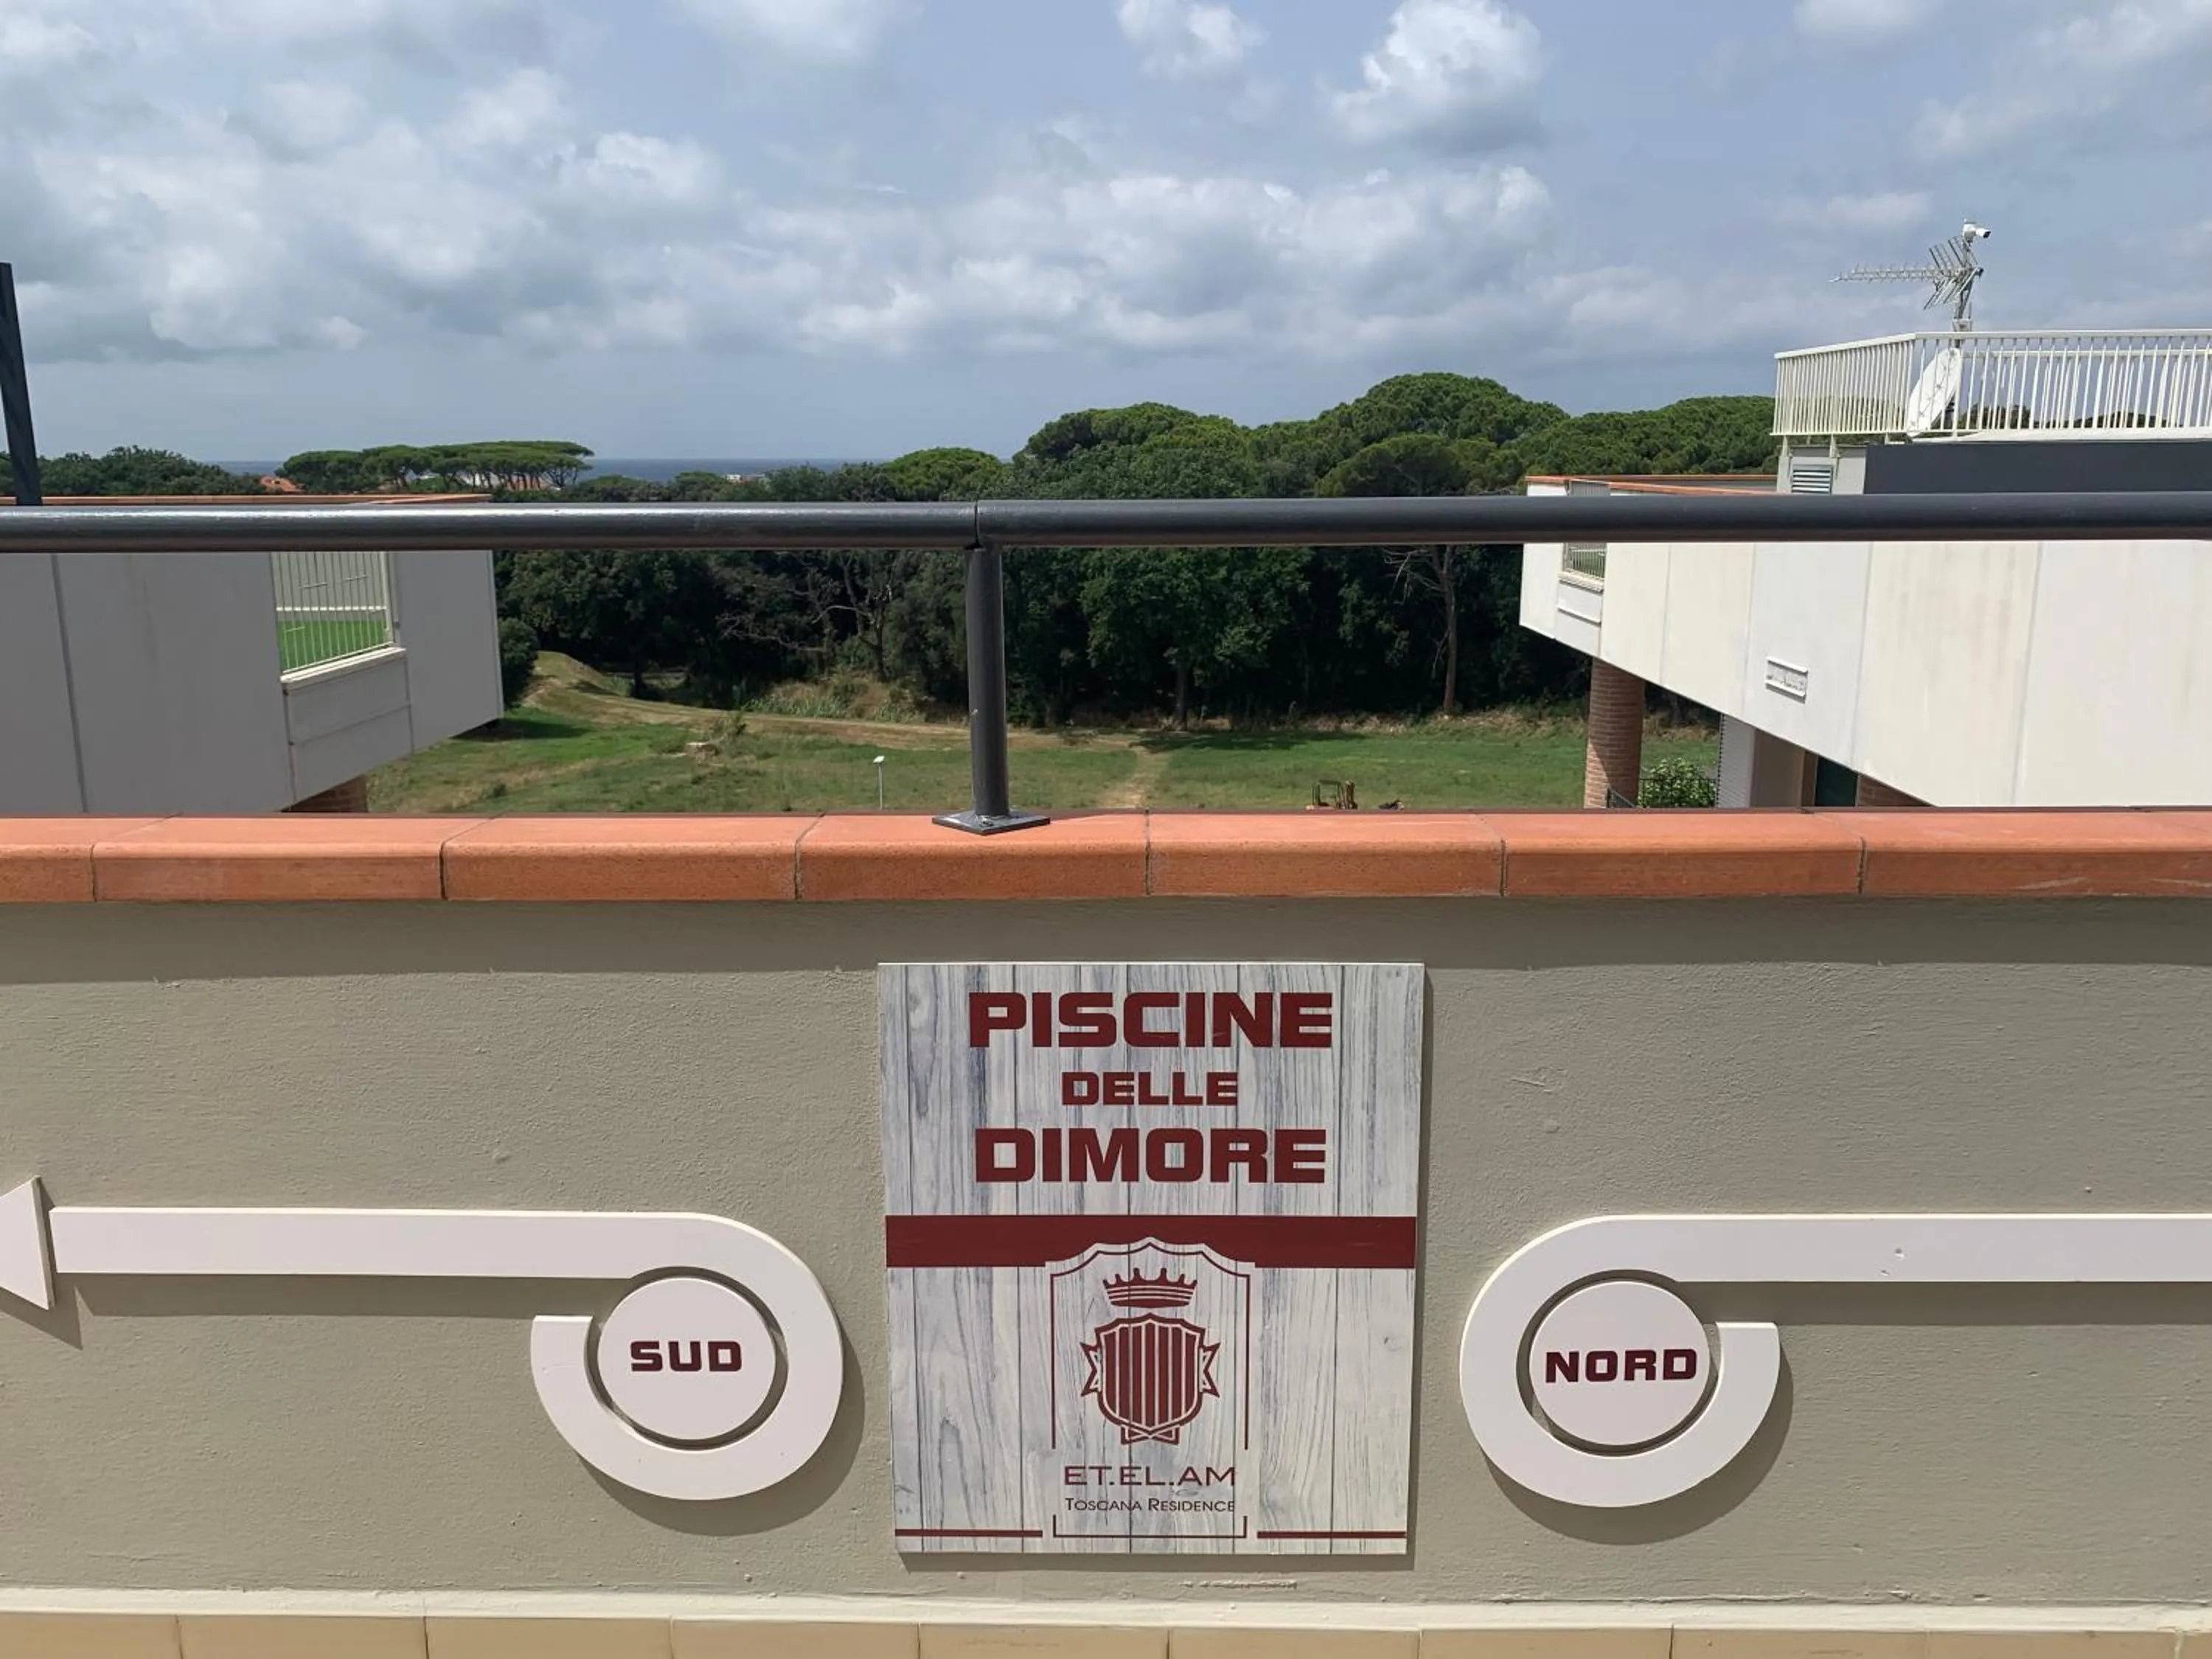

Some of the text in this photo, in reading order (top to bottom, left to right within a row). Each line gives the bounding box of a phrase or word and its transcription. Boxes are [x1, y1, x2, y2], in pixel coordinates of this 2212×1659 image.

[969, 991, 1333, 1048] PISCINE
[1061, 1071, 1239, 1106] DELLE
[975, 1127, 1327, 1184] DIMORE
[630, 1340, 742, 1372] SUD
[1545, 1348, 1697, 1383] NORD
[1064, 1466, 1236, 1486] ET.EL.AM
